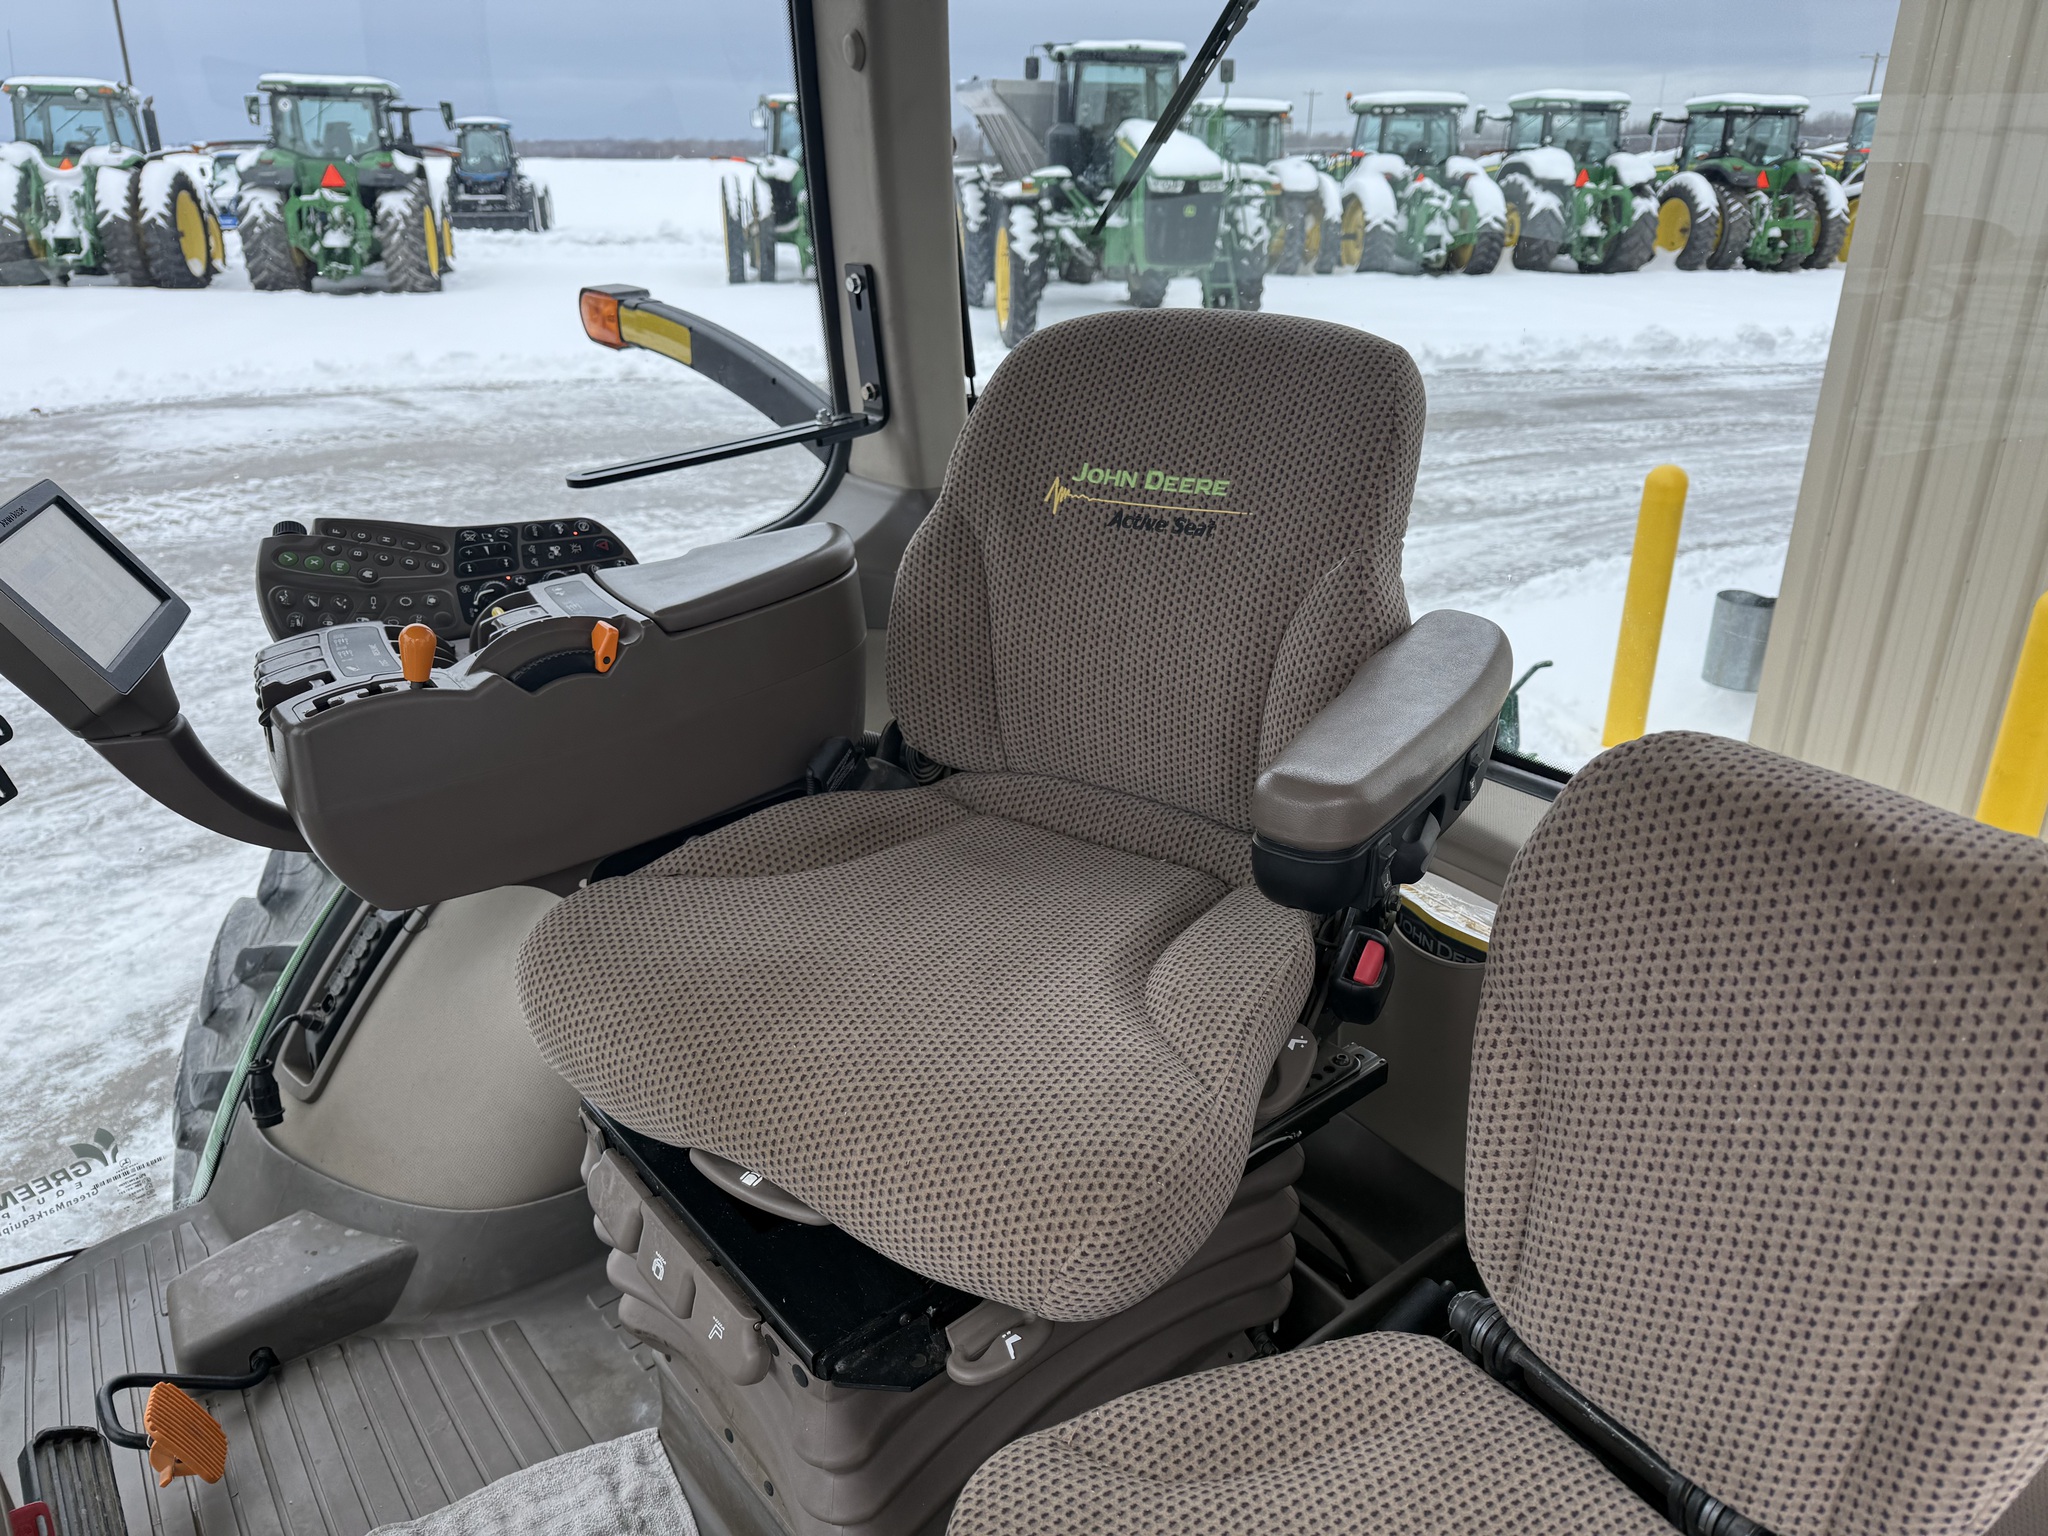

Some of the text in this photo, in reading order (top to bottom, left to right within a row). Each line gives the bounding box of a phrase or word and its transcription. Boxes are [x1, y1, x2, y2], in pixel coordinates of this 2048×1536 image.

[1072, 462, 1230, 496] JOHN DEERE
[1107, 510, 1217, 537] Active Seat
